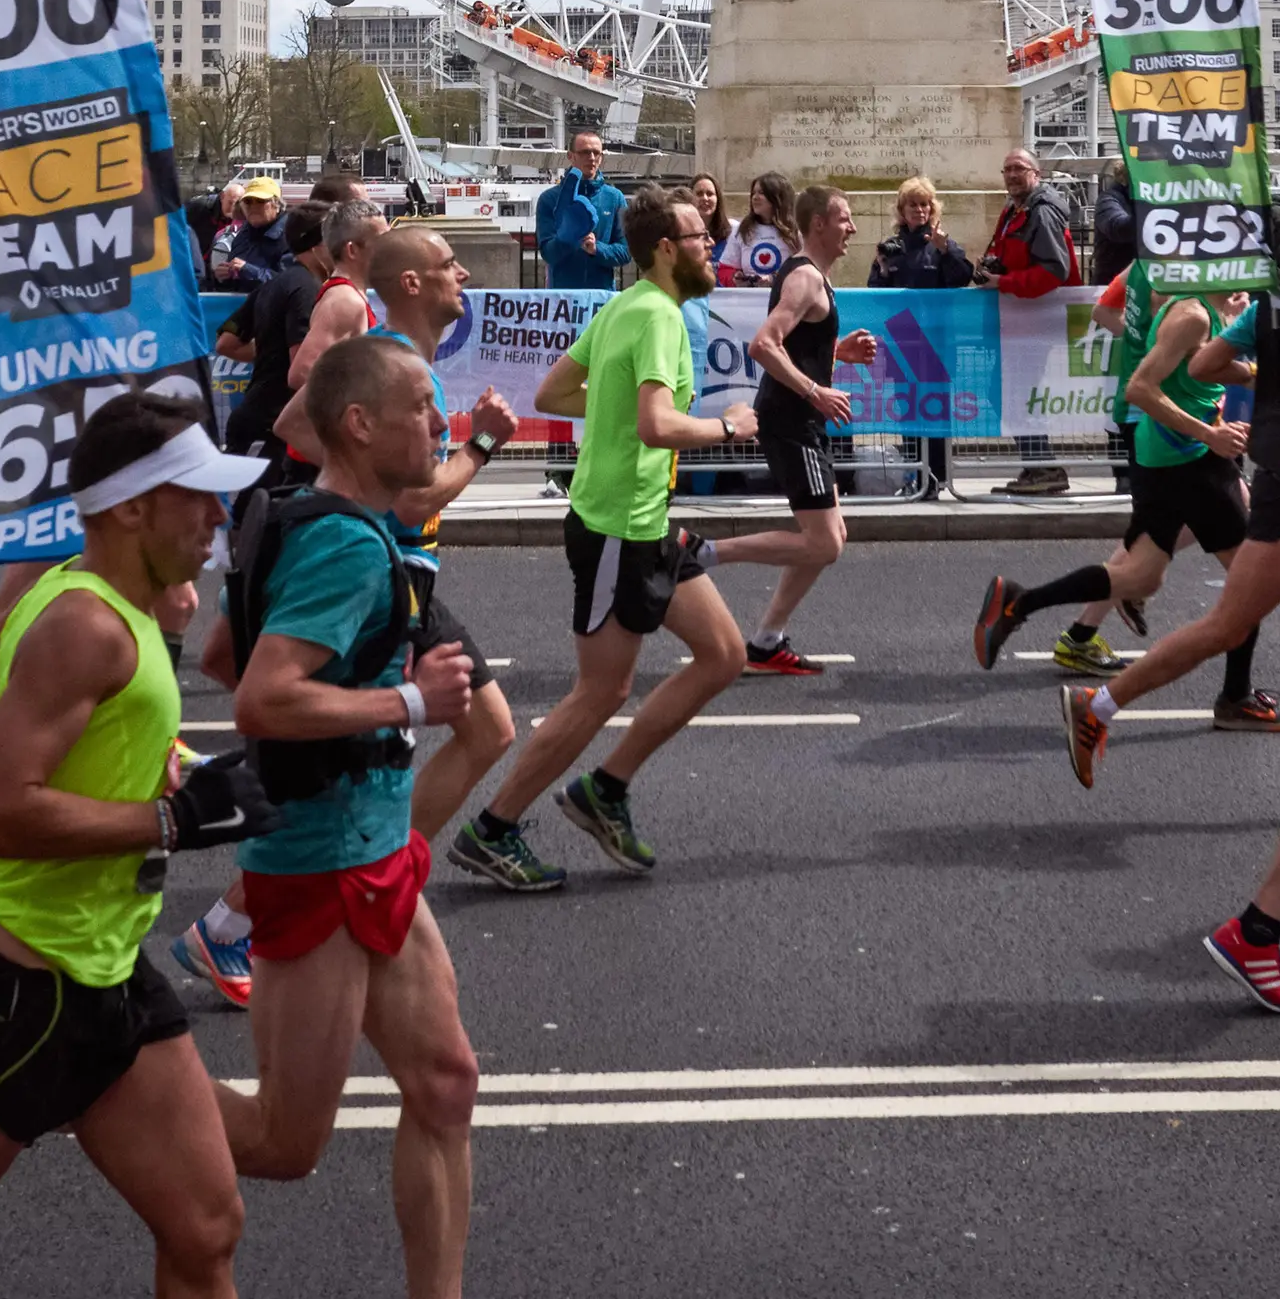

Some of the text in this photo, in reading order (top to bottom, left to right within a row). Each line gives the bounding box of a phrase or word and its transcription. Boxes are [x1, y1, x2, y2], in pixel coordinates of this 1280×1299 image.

[1135, 52, 1237, 72] RUNNER'S WORLD
[1133, 77, 1241, 106] PACE
[49, 102, 118, 130] WORLD
[1132, 113, 1237, 142] TEAM
[1148, 260, 1271, 283] PER MILE
[43, 278, 119, 301] RENAULT
[484, 292, 550, 324] Royal
[554, 299, 590, 325] Air
[481, 320, 578, 352] Benevol
[479, 347, 544, 365] THE HEART
[851, 384, 979, 423] didas
[1027, 386, 1116, 416] Holida
